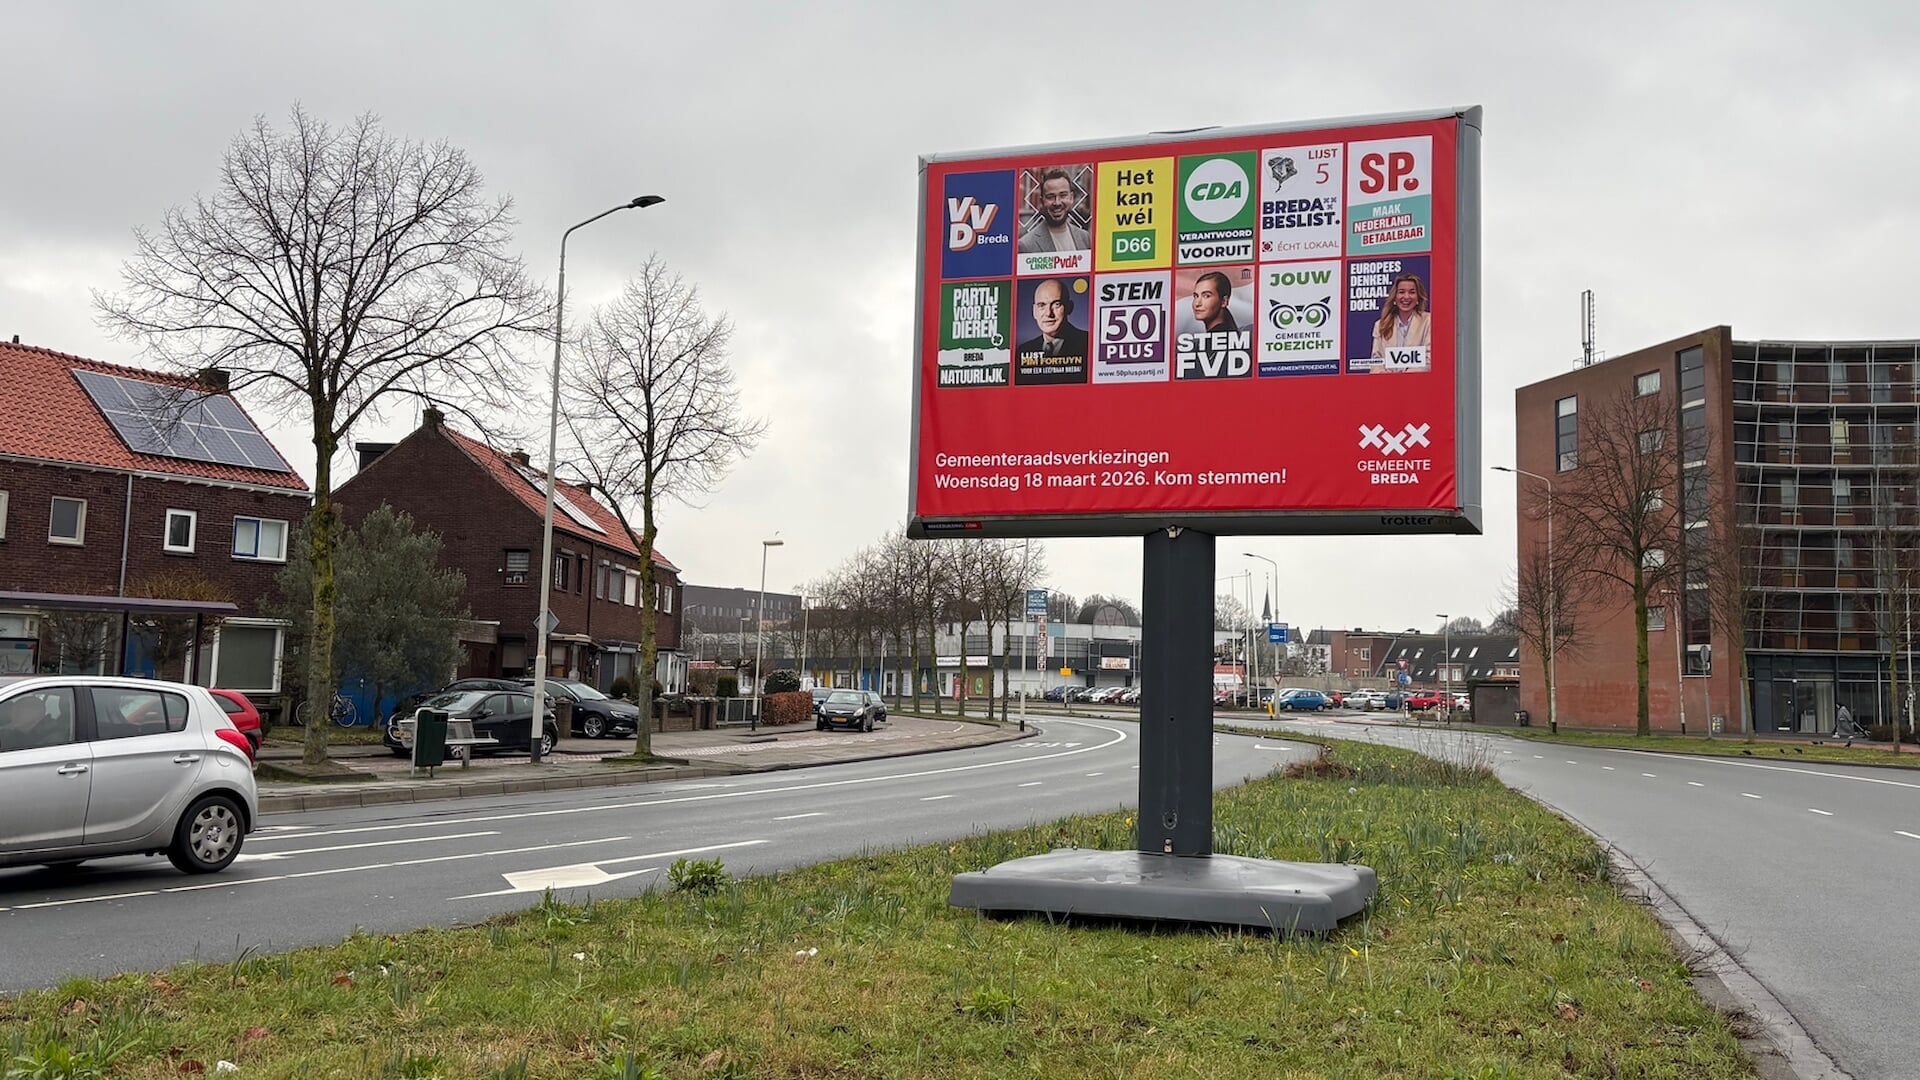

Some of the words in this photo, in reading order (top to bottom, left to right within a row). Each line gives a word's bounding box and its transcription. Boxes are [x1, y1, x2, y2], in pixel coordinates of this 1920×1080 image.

[1308, 149, 1338, 160] LIJST
[1117, 169, 1154, 186] Het
[1315, 163, 1329, 185] 5
[1116, 190, 1153, 206] kan
[1190, 181, 1242, 201] CDA
[1262, 198, 1325, 214] BREDA
[1372, 204, 1401, 217] MAAK
[1116, 208, 1152, 226] wél
[1262, 212, 1340, 229] BESLIST.
[1354, 215, 1411, 233] NEDERLAND
[977, 234, 1009, 245] Breda
[1179, 229, 1253, 241] VERANTWOORD
[1362, 227, 1424, 245] BETAALBAAR
[1116, 237, 1151, 253] D66
[1180, 244, 1251, 259] VOORUIT
[1277, 242, 1301, 251] ÉCHT
[1304, 241, 1339, 250] LOKAAL
[1025, 256, 1054, 265] GROEN
[1030, 262, 1053, 271] LINKS
[1350, 260, 1402, 275] EUROPEES
[1269, 270, 1332, 287] JOUW
[1350, 274, 1393, 287] DENKEN.
[953, 287, 999, 307] PARTIJ
[1100, 281, 1163, 302] STEM
[953, 305, 981, 321] VOOR
[984, 305, 998, 319] DE
[1350, 299, 1379, 312] DOEN.
[952, 320, 997, 340] DIEREN
[1106, 307, 1157, 341] 50
[1177, 331, 1250, 352] STEM
[1275, 331, 1321, 340] GEMEENTE
[1106, 343, 1154, 359] PLUS
[1265, 339, 1334, 351] TOEZICHT
[963, 352, 984, 362] BREDA
[1020, 351, 1045, 359] LIJST
[1021, 357, 1039, 366] PIM
[1040, 356, 1082, 366] FORTUYN
[1389, 350, 1422, 364] Volt
[1176, 350, 1251, 378] FVD
[940, 368, 1006, 385] NATUURLIJK.
[1098, 368, 1164, 377] www.50pluspartij.nl
[935, 449, 1169, 468] Gemeenteraadsverkiezingen
[1357, 459, 1431, 472] GEMEENTE
[935, 473, 1020, 491] Woensdag
[1024, 473, 1043, 487] 18
[1047, 473, 1096, 487] maart
[1101, 471, 1150, 486] 2026.
[1154, 470, 1193, 485] Kom
[1197, 468, 1287, 485] stemmen!
[1371, 473, 1419, 484] BREDA
[1380, 515, 1434, 526] trotter
